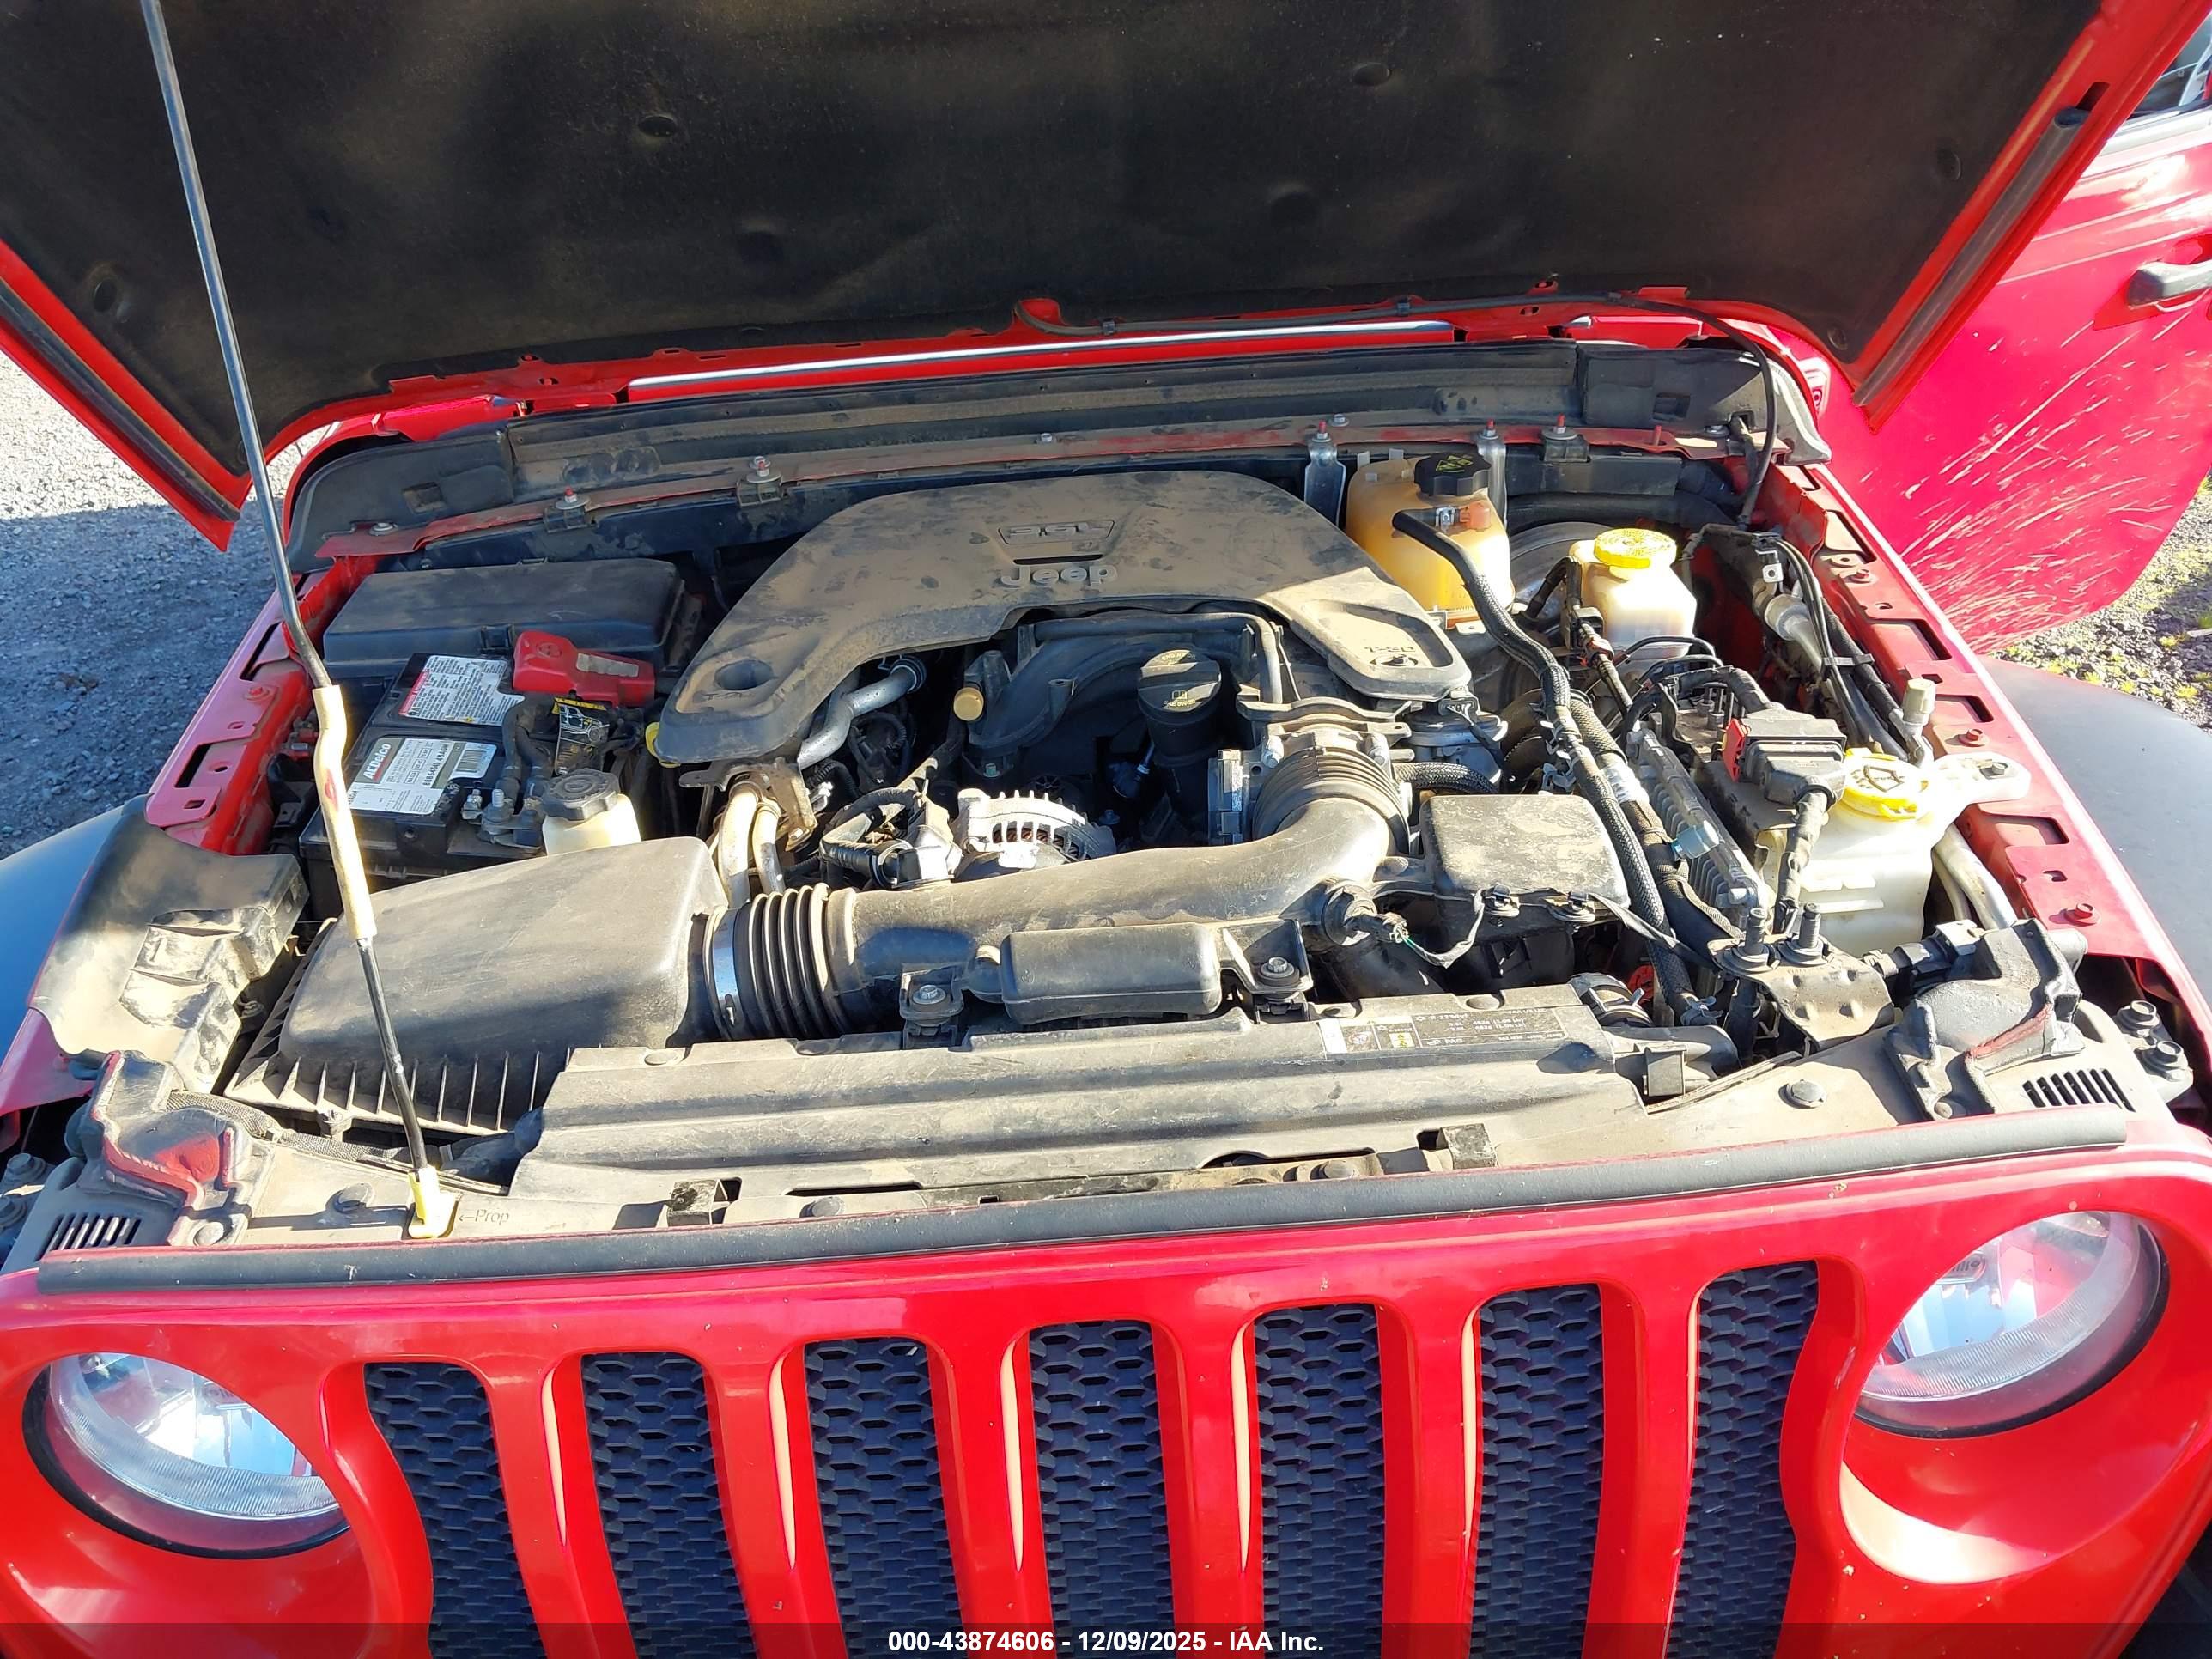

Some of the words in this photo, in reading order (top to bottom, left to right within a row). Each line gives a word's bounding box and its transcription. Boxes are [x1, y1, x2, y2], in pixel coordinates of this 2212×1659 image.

[1000, 564, 1117, 590] Jeep
[362, 743, 392, 781] ACDelco
[475, 1209, 510, 1226] Prop
